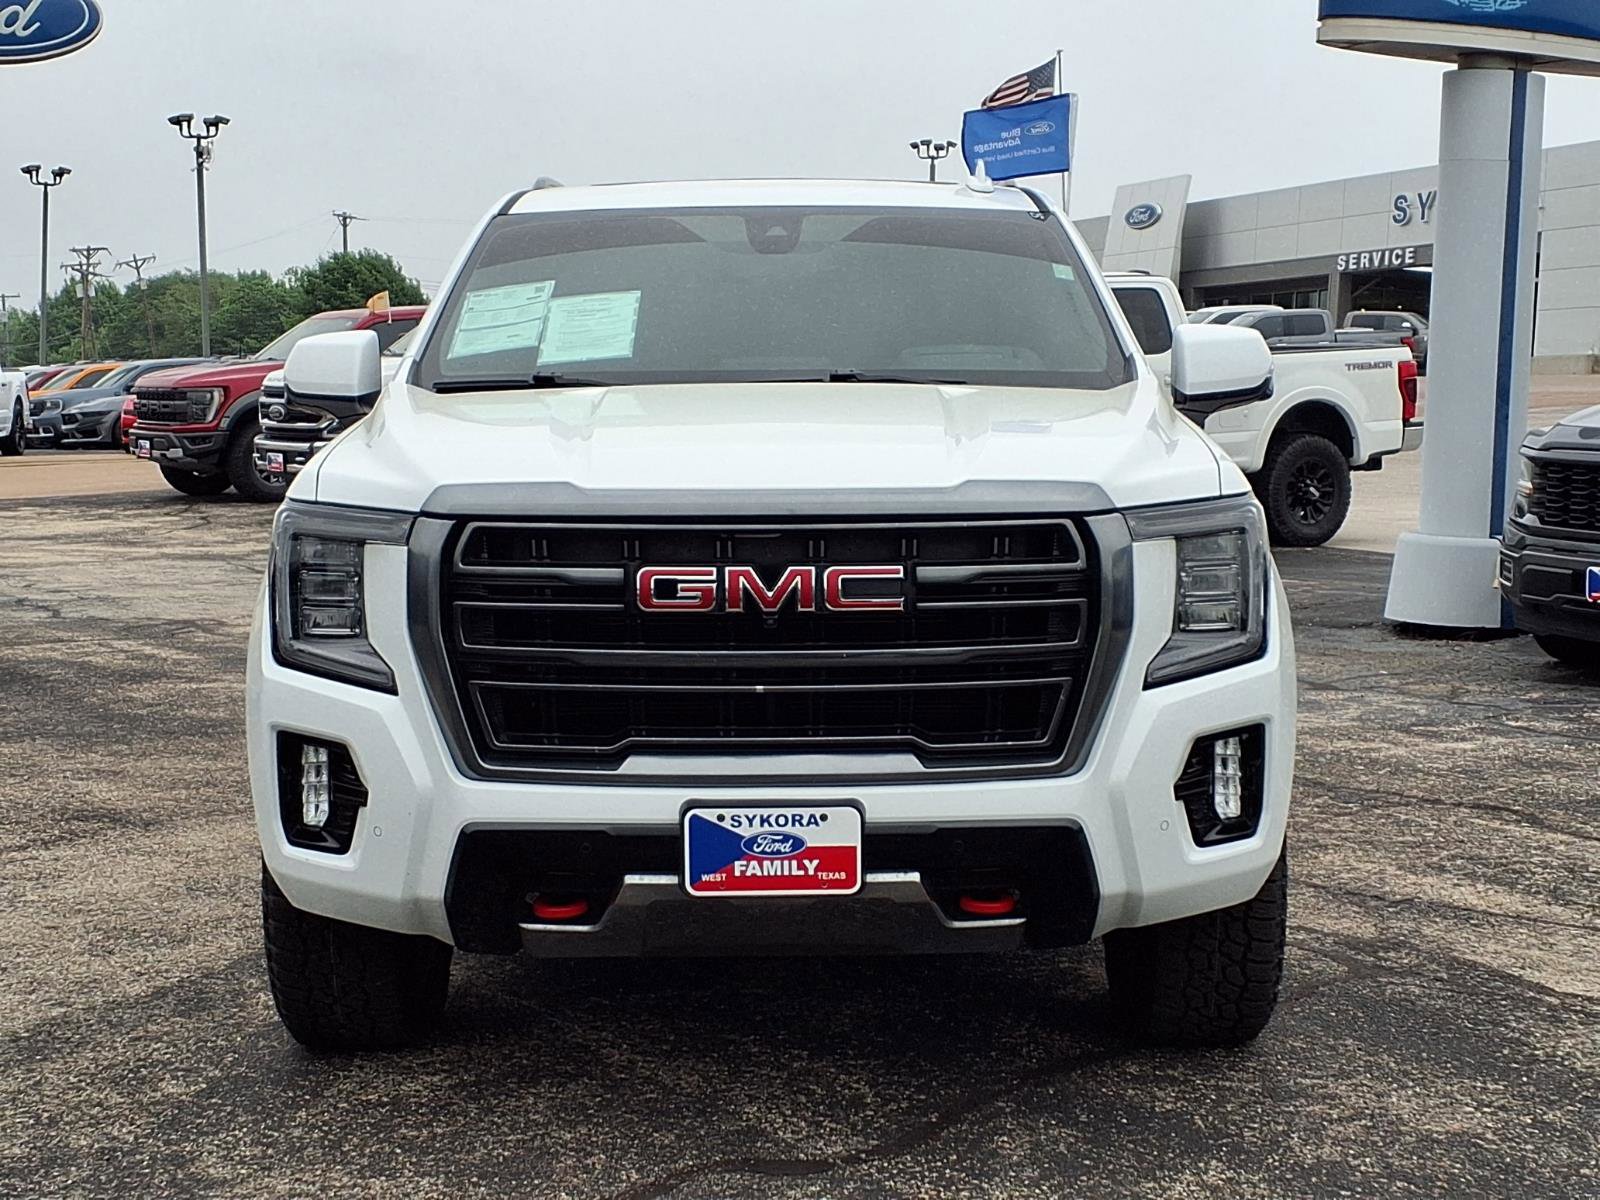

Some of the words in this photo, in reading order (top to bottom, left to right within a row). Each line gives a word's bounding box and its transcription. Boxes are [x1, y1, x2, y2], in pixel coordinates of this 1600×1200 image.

[1337, 247, 1415, 271] SERVICE
[1345, 360, 1393, 372] TREMOR
[637, 566, 904, 612] GMC
[730, 813, 821, 828] SYKORA
[752, 834, 794, 853] Ford
[701, 873, 727, 882] WEST
[817, 871, 847, 880] TEXAS
[734, 859, 820, 877] FAMILY
